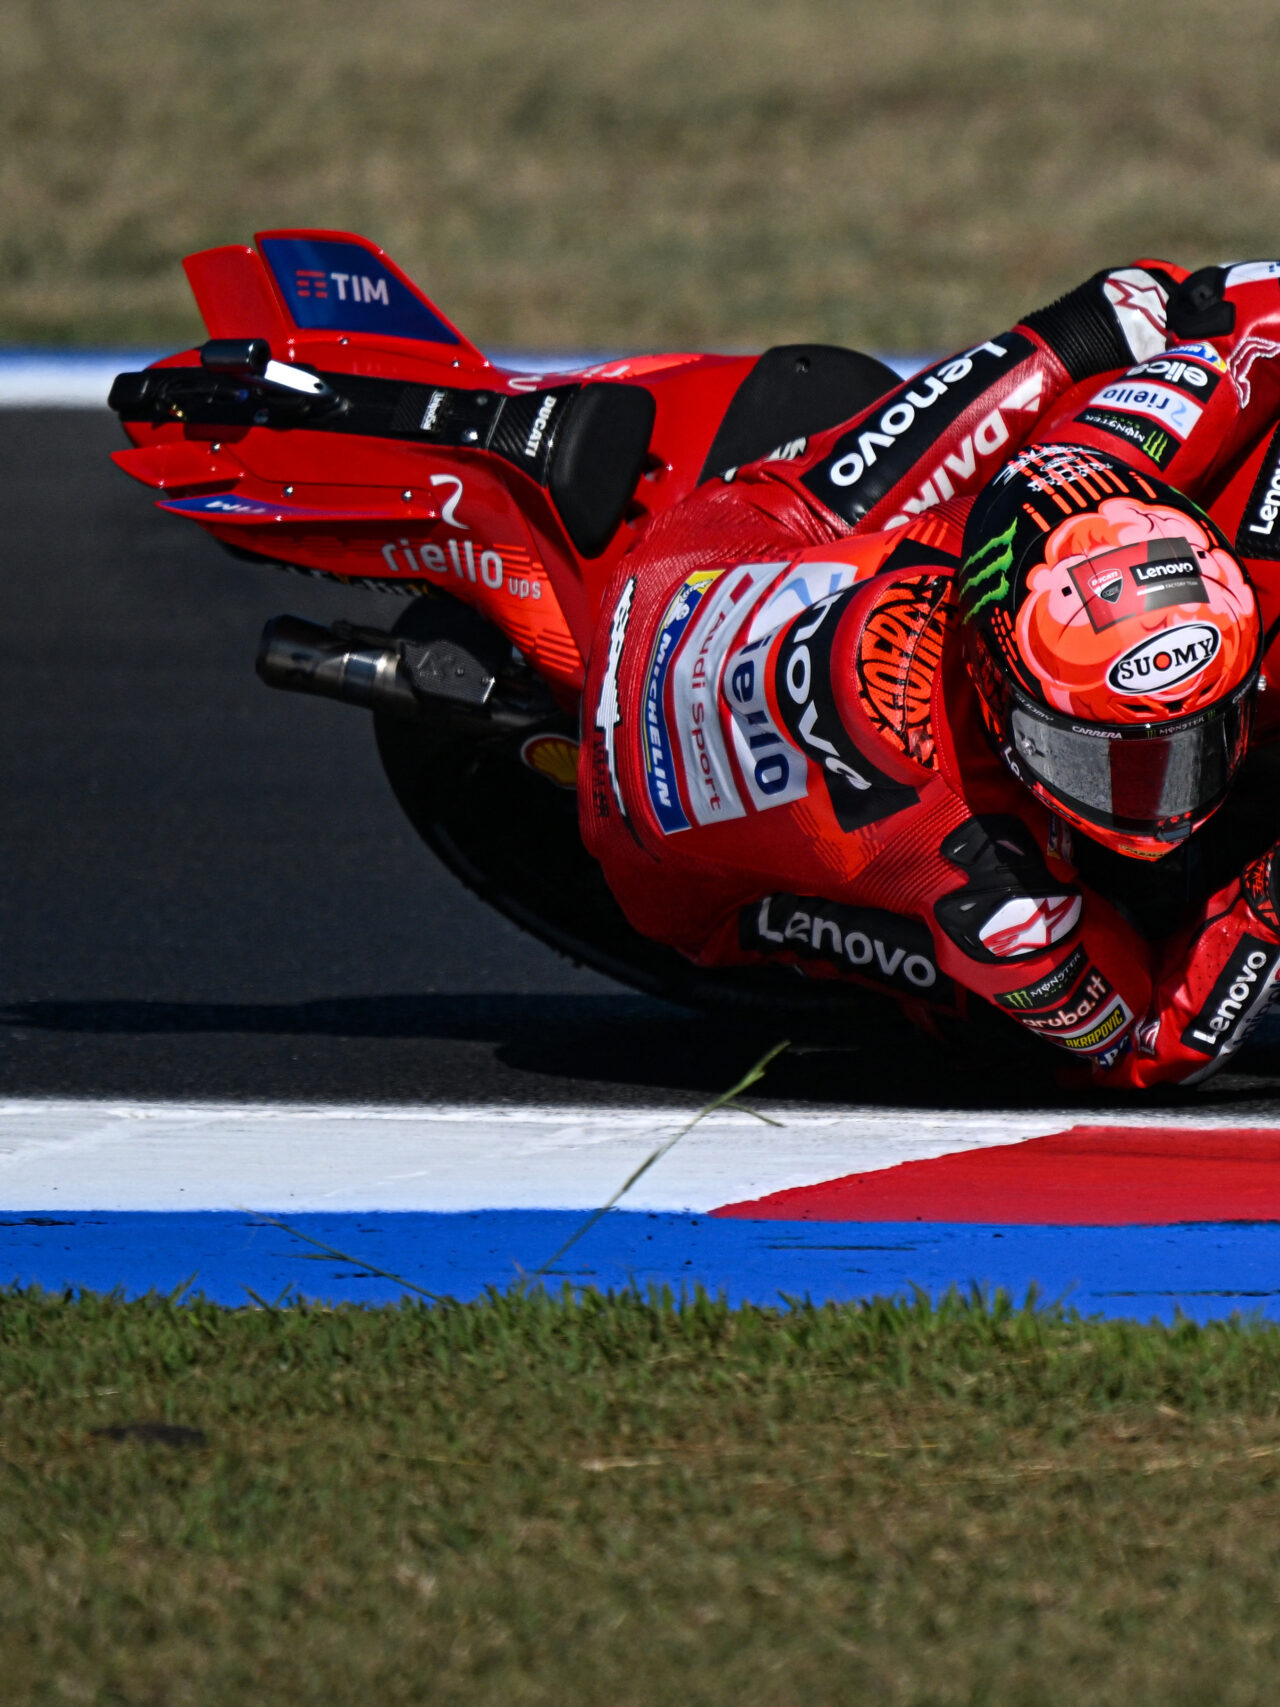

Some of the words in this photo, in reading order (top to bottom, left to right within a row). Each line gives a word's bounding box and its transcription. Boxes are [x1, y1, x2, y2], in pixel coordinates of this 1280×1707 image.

[330, 272, 389, 305] TIM
[525, 394, 558, 458] DUCATI
[829, 341, 1008, 487] Lenovo
[1084, 413, 1146, 444] MONSTER
[1102, 388, 1171, 411] riello
[381, 539, 503, 589] riello
[508, 577, 541, 600] ups
[1135, 562, 1194, 581] Lenovo
[692, 610, 725, 690] Audi
[1119, 638, 1213, 680] SUOMY
[643, 633, 674, 808] MICHELIN
[731, 635, 791, 797] iello
[1072, 725, 1123, 740] CARRERA
[691, 701, 722, 812] Sport
[757, 896, 937, 988] Lenovo
[1030, 951, 1082, 998] MONSTER
[1192, 950, 1267, 1045] Lenovo
